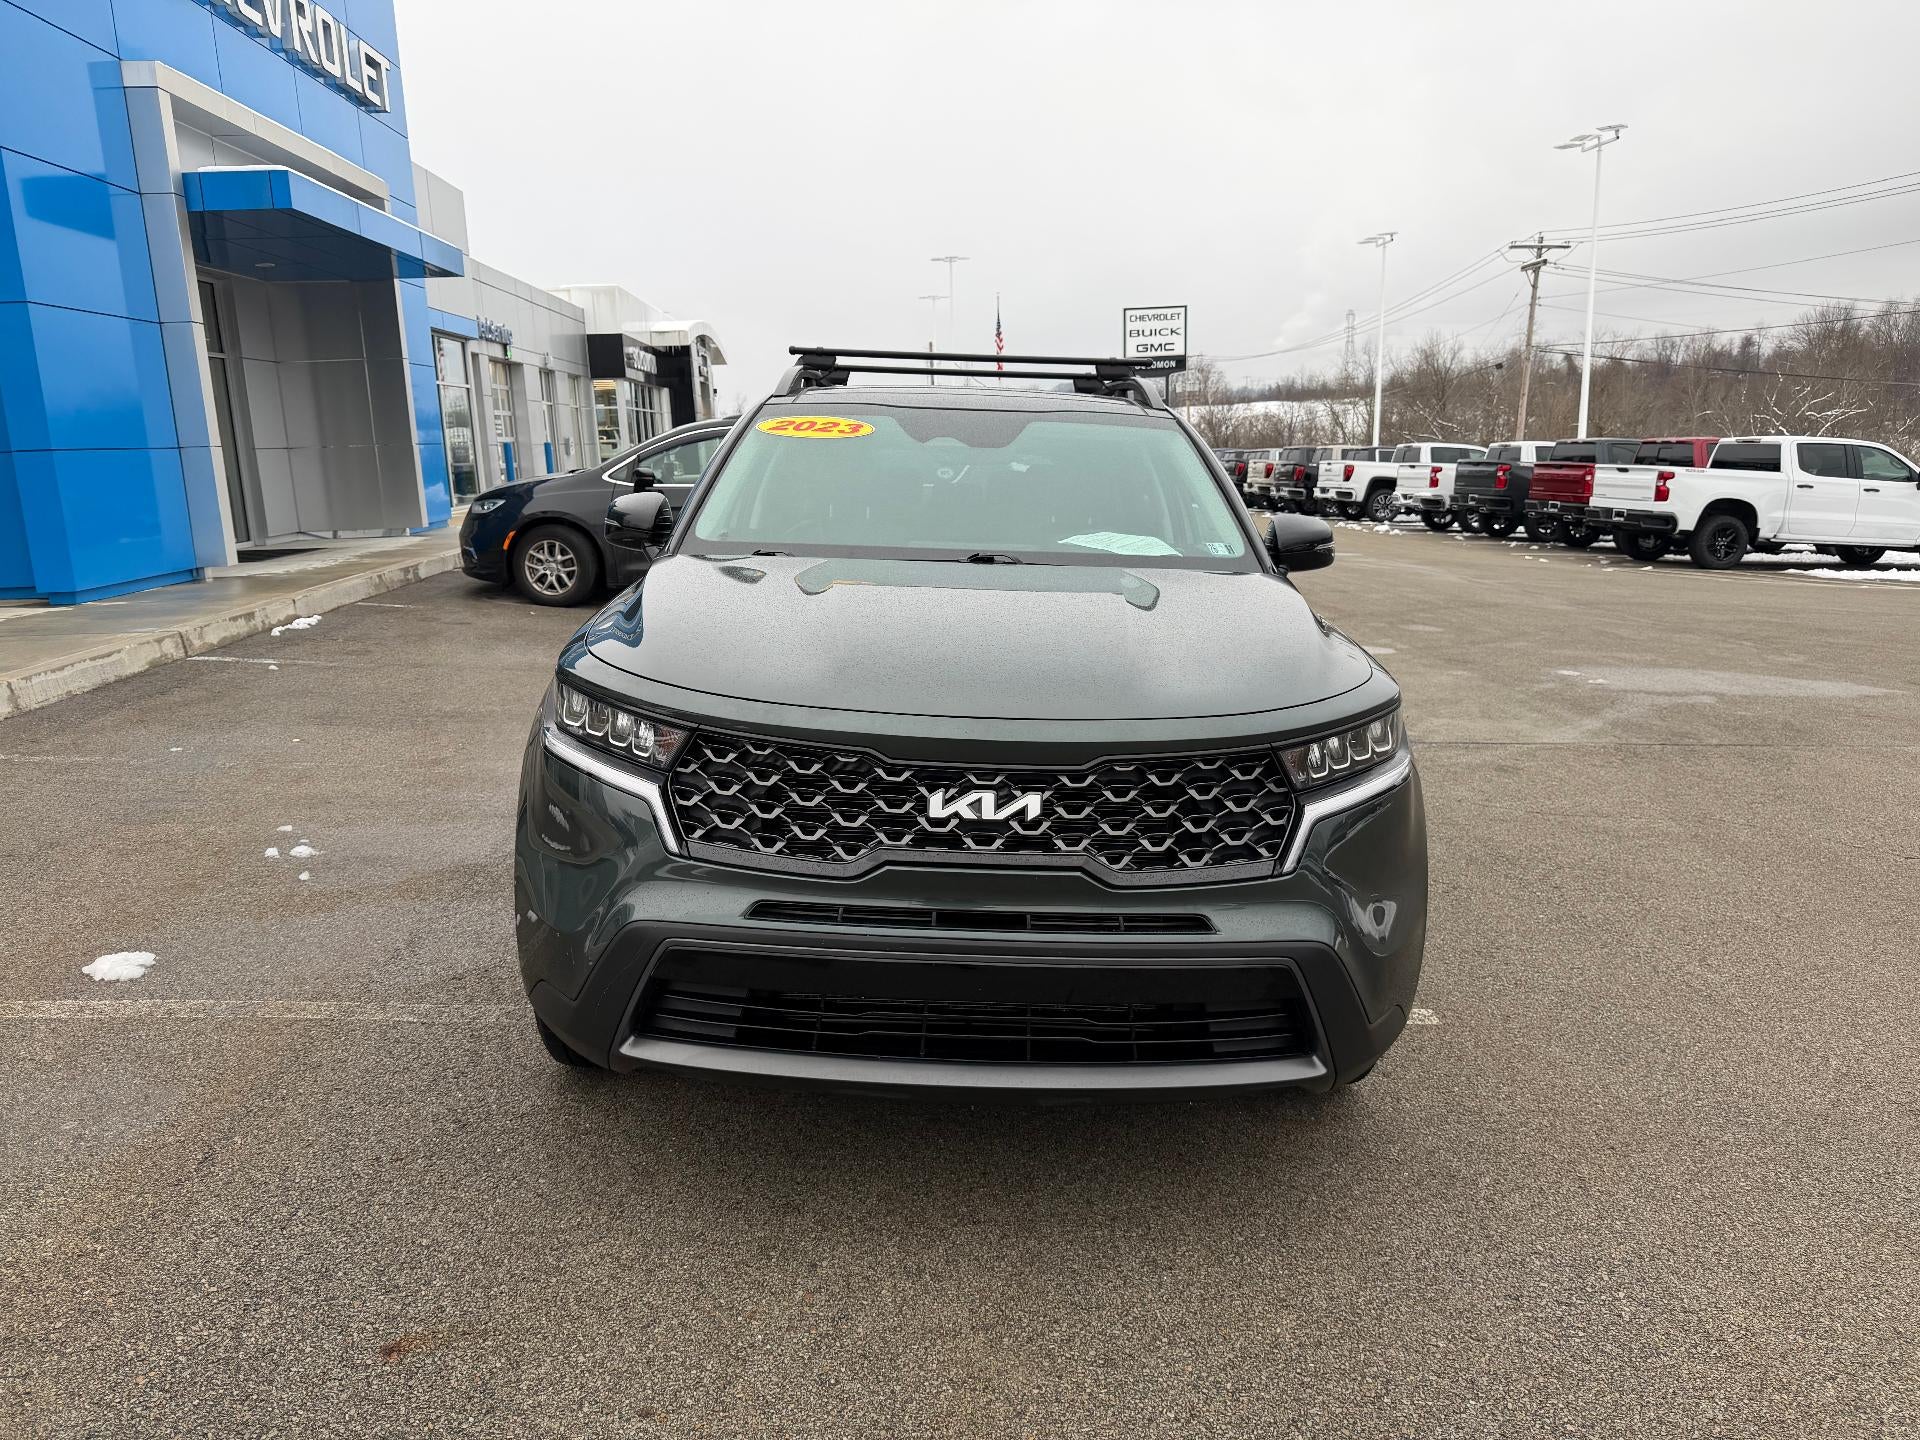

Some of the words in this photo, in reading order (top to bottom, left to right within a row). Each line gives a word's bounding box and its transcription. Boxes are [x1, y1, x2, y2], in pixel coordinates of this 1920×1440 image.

[1129, 313, 1181, 322] CHEVROLET
[1129, 328, 1181, 337] BUICK
[1136, 343, 1175, 352] GMC
[767, 420, 864, 434] 2023
[927, 787, 1043, 821] KIA
